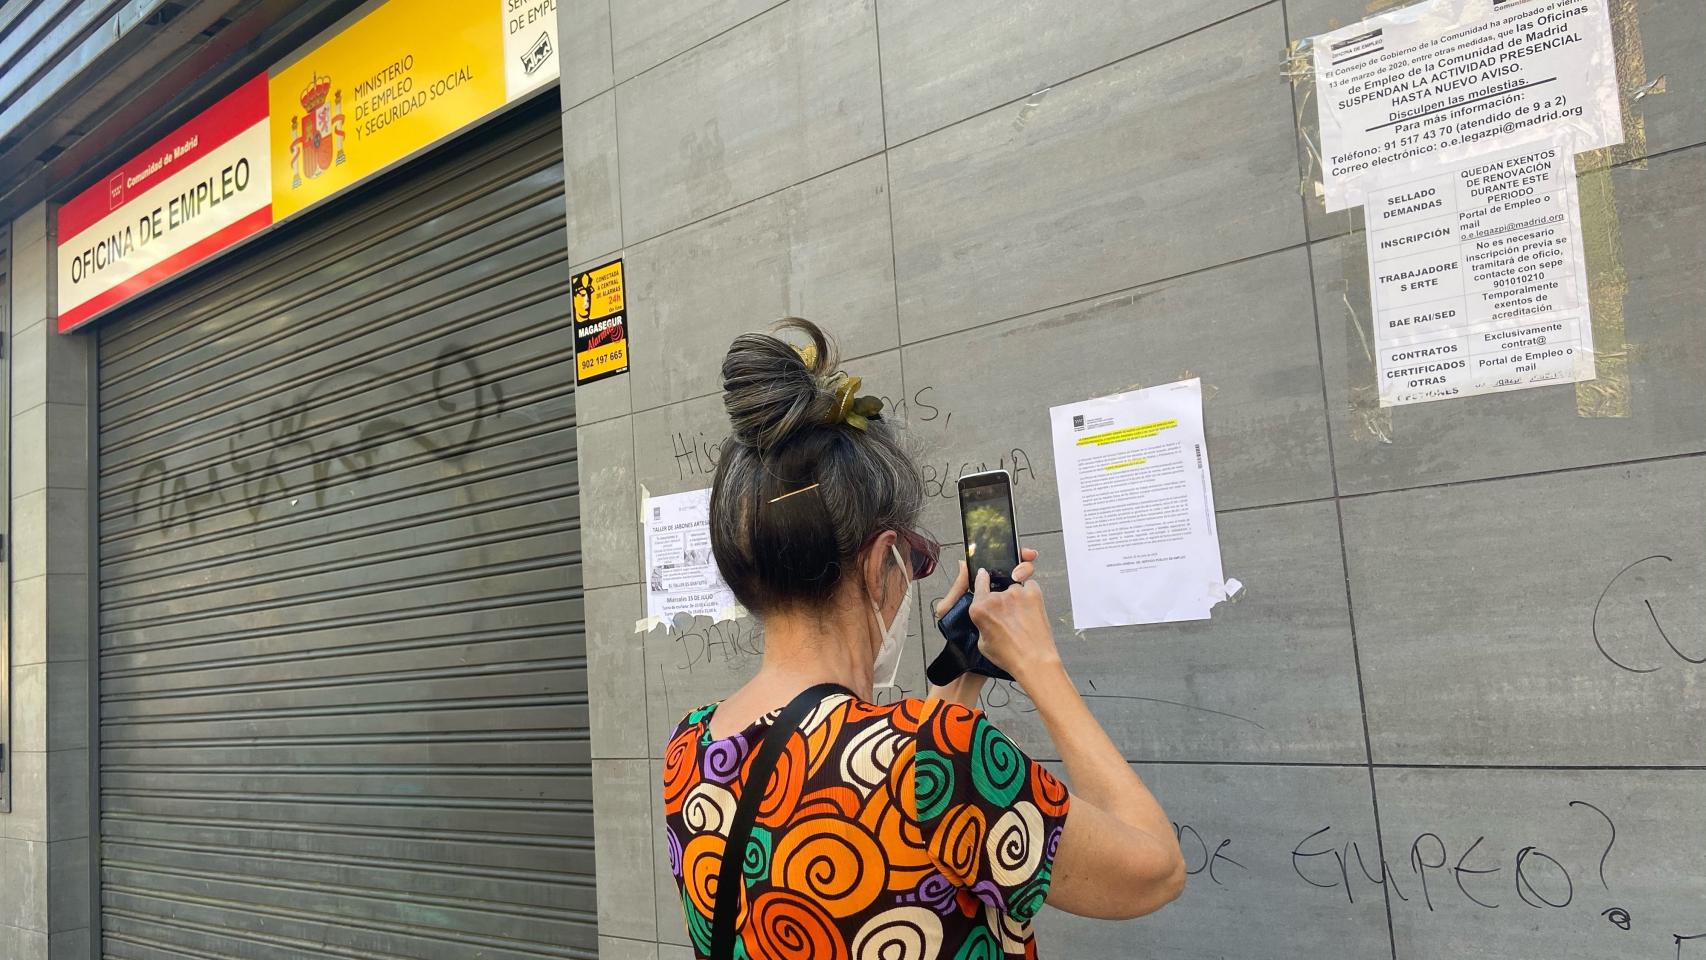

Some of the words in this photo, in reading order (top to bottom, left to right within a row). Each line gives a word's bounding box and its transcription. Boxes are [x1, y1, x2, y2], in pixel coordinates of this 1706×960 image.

[510, 14, 524, 34] DE
[1325, 70, 1333, 78] El
[1335, 62, 1367, 77] Consejo
[1368, 58, 1378, 66] de
[1380, 46, 1417, 62] Gobierno
[1419, 42, 1429, 50] de
[1430, 38, 1438, 46] la
[1440, 22, 1488, 43] Comunidad
[1490, 20, 1501, 28] ha
[1502, 6, 1544, 25] aprobado
[1546, 2, 1555, 10] el
[1340, 78, 1350, 86] de
[1351, 71, 1374, 82] marzo
[1388, 59, 1410, 72] 2020,
[1412, 53, 1432, 64] entre
[1434, 47, 1455, 58] otras
[1457, 34, 1496, 50] medidas,
[1498, 29, 1514, 38] que
[1515, 22, 1534, 33] las
[1537, 4, 1588, 26] Oficinas
[1348, 86, 1361, 95] de
[1364, 72, 1405, 91] Empleo
[1408, 66, 1421, 78] de
[1424, 63, 1435, 72] la
[1438, 41, 1504, 68] Comunidad
[1508, 37, 1522, 48] de
[1526, 22, 1568, 42] Madrid
[354, 55, 414, 101] MINISTERIO
[1338, 82, 1409, 110] SUSPENDAN
[1412, 76, 1428, 88] LA
[1430, 56, 1496, 83] ACTIVIDAD
[1500, 32, 1582, 62] PRESENCIAL
[1391, 90, 1431, 107] HASTA
[1434, 75, 1478, 92] NUEVO
[1481, 63, 1523, 82] AVISO.
[355, 102, 369, 121] DE
[372, 77, 412, 112] EMPLEO
[356, 124, 362, 140] Y
[365, 91, 427, 136] SEGURIDAD
[430, 65, 473, 100] SOCIAL
[1389, 101, 1445, 121] Disculpen
[1448, 95, 1465, 104] las
[1468, 78, 1529, 100] molestias.
[1395, 122, 1420, 134] Para
[1423, 114, 1447, 126] más
[1450, 92, 1525, 118] información:
[1331, 147, 1381, 165] Teléfono:
[1384, 140, 1396, 150] 91
[1400, 134, 1420, 146] 517
[1422, 130, 1436, 140] 43
[1440, 126, 1452, 136] 70
[1456, 112, 1511, 134] (atendido
[1514, 106, 1530, 116] de
[1533, 102, 1540, 111] 9
[1554, 96, 1566, 106] 2)
[1332, 162, 1369, 177] Correo
[1372, 142, 1437, 166] electrónico:
[1440, 106, 1583, 148] o.e.legazpi@madrid.org
[126, 157, 164, 189] Comunidad
[164, 152, 172, 167] de
[173, 135, 199, 160] Madrid
[1461, 161, 1504, 178] QUEDAN
[1506, 150, 1555, 168] EXENTOS
[1466, 178, 1480, 188] DE
[1470, 179, 1520, 197] DURANTE
[1522, 172, 1550, 186] ESTE
[1388, 188, 1436, 206] SELLADO
[1488, 186, 1534, 204] PERIODO
[1383, 198, 1442, 218] DEMANDAS
[1460, 208, 1487, 220] Portal
[1490, 206, 1501, 214] de
[1504, 198, 1541, 210] Empleo
[72, 225, 134, 284] OFICINA
[140, 207, 163, 246] DE
[168, 158, 250, 230] EMPLEO
[1460, 220, 1480, 230] mail
[1380, 226, 1450, 249] INSCRIPCIÓN
[1476, 242, 1490, 250] No
[1506, 228, 1554, 244] necesario
[1466, 247, 1520, 262] inscripción
[1522, 240, 1553, 252] previa
[1556, 236, 1568, 244] se
[1379, 262, 1459, 284] TRABAJADORE
[1472, 258, 1515, 271] tramitará
[1518, 254, 1530, 262] de
[1474, 267, 1516, 282] contacte
[1518, 264, 1536, 274] con
[1539, 259, 1563, 272] sepe
[1400, 284, 1408, 292] S
[1410, 278, 1438, 290] ERTE
[1482, 281, 1558, 301] Temporalmente
[1494, 272, 1545, 288] 901010210
[1492, 304, 1552, 320] acreditación
[1494, 296, 1533, 310] exentos
[1535, 294, 1548, 302] de
[578, 316, 622, 338] MAGASEGUR
[1389, 318, 1410, 328] BAE
[1414, 310, 1456, 324] RAI/SED
[1484, 324, 1562, 342] Exclusivamente
[1501, 336, 1547, 350] contrat@
[582, 358, 594, 370] 902
[596, 354, 608, 364] 197
[610, 350, 622, 361] 665
[1391, 344, 1458, 362] CONTRATOS
[1479, 356, 1508, 368] Portal
[1510, 354, 1522, 362] de
[1525, 348, 1564, 361] Empleo
[1386, 360, 1466, 379] CERTIFICADOS
[1516, 362, 1536, 372] mail
[1407, 375, 1446, 388] /OTRAS
[652, 524, 667, 532] TALLER
